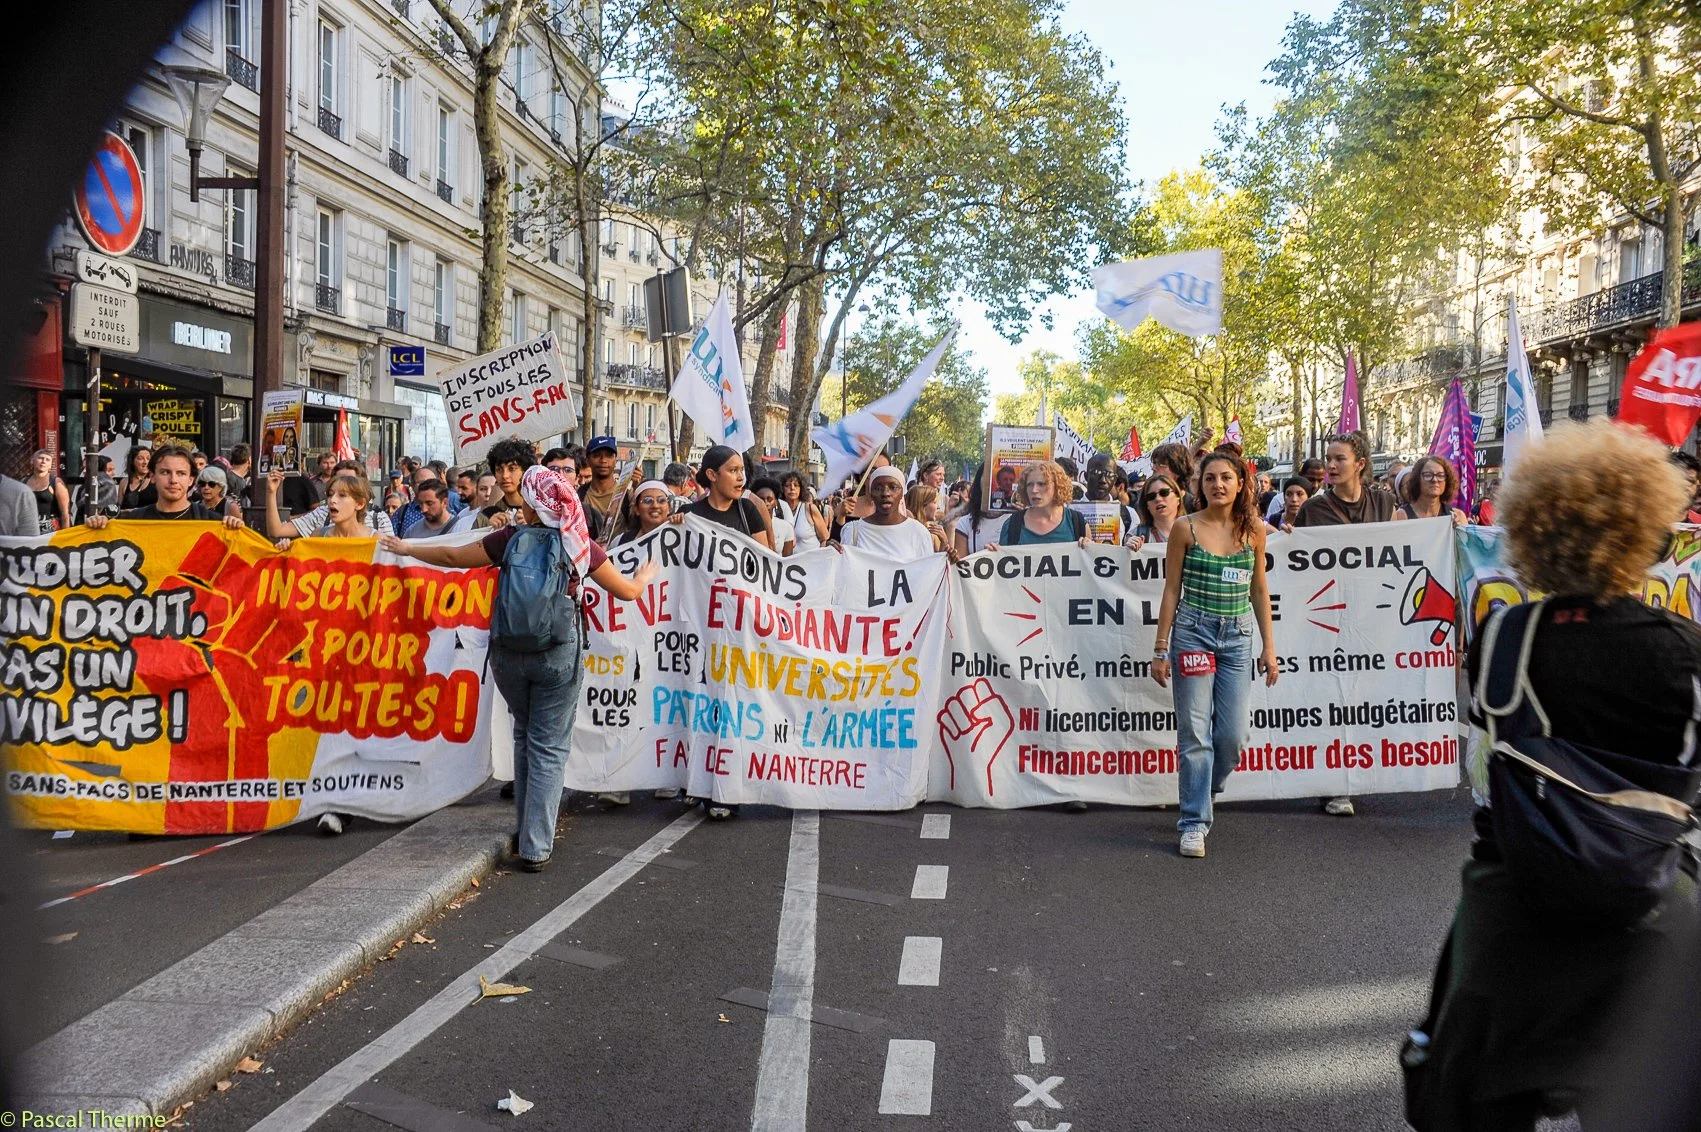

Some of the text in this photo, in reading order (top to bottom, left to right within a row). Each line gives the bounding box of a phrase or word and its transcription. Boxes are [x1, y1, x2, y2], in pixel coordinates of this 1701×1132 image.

[90, 291, 127, 308] INTERDIT
[98, 306, 119, 319] SAUF
[84, 328, 131, 346] MOTORISÉS
[90, 318, 126, 332] 2 ROUES
[393, 353, 420, 363] LCL
[443, 337, 553, 399] INSCRIPTION
[450, 363, 552, 413] DE TOUS LES
[149, 401, 177, 411] WRAP
[151, 411, 192, 421] CRISPY
[153, 423, 200, 433] POULET
[0, 545, 144, 590] UDIER
[610, 527, 913, 608] STRUISONS LA
[957, 554, 1082, 580] SOCIAL
[1094, 556, 1119, 578] &
[1288, 545, 1424, 571] SOCIAL
[256, 567, 494, 620] INSCRIPTION
[65, 591, 206, 643] DROIT.
[1068, 598, 1124, 625] EN
[321, 627, 420, 677] POUR
[654, 631, 699, 653] POUR
[0, 648, 133, 691] AS UN
[657, 652, 691, 676] LES
[951, 651, 1153, 681] Public Privé, mêm
[1183, 653, 1211, 668] NPA
[1309, 647, 1386, 672] même
[454, 681, 468, 733] !
[587, 686, 637, 708] POUR
[172, 690, 184, 739] !
[592, 708, 631, 728] LES
[652, 685, 765, 741] PATRONS
[802, 700, 917, 749] L'ARMÉE
[1019, 708, 1040, 731] Ni
[1328, 698, 1456, 729] budgétaires
[1326, 738, 1374, 769] des
[748, 752, 868, 790] NANTERRE
[135, 783, 163, 800] DE
[169, 780, 278, 800] NANTERRE
[284, 780, 306, 797] ET
[312, 774, 405, 794] SOUTIENS
